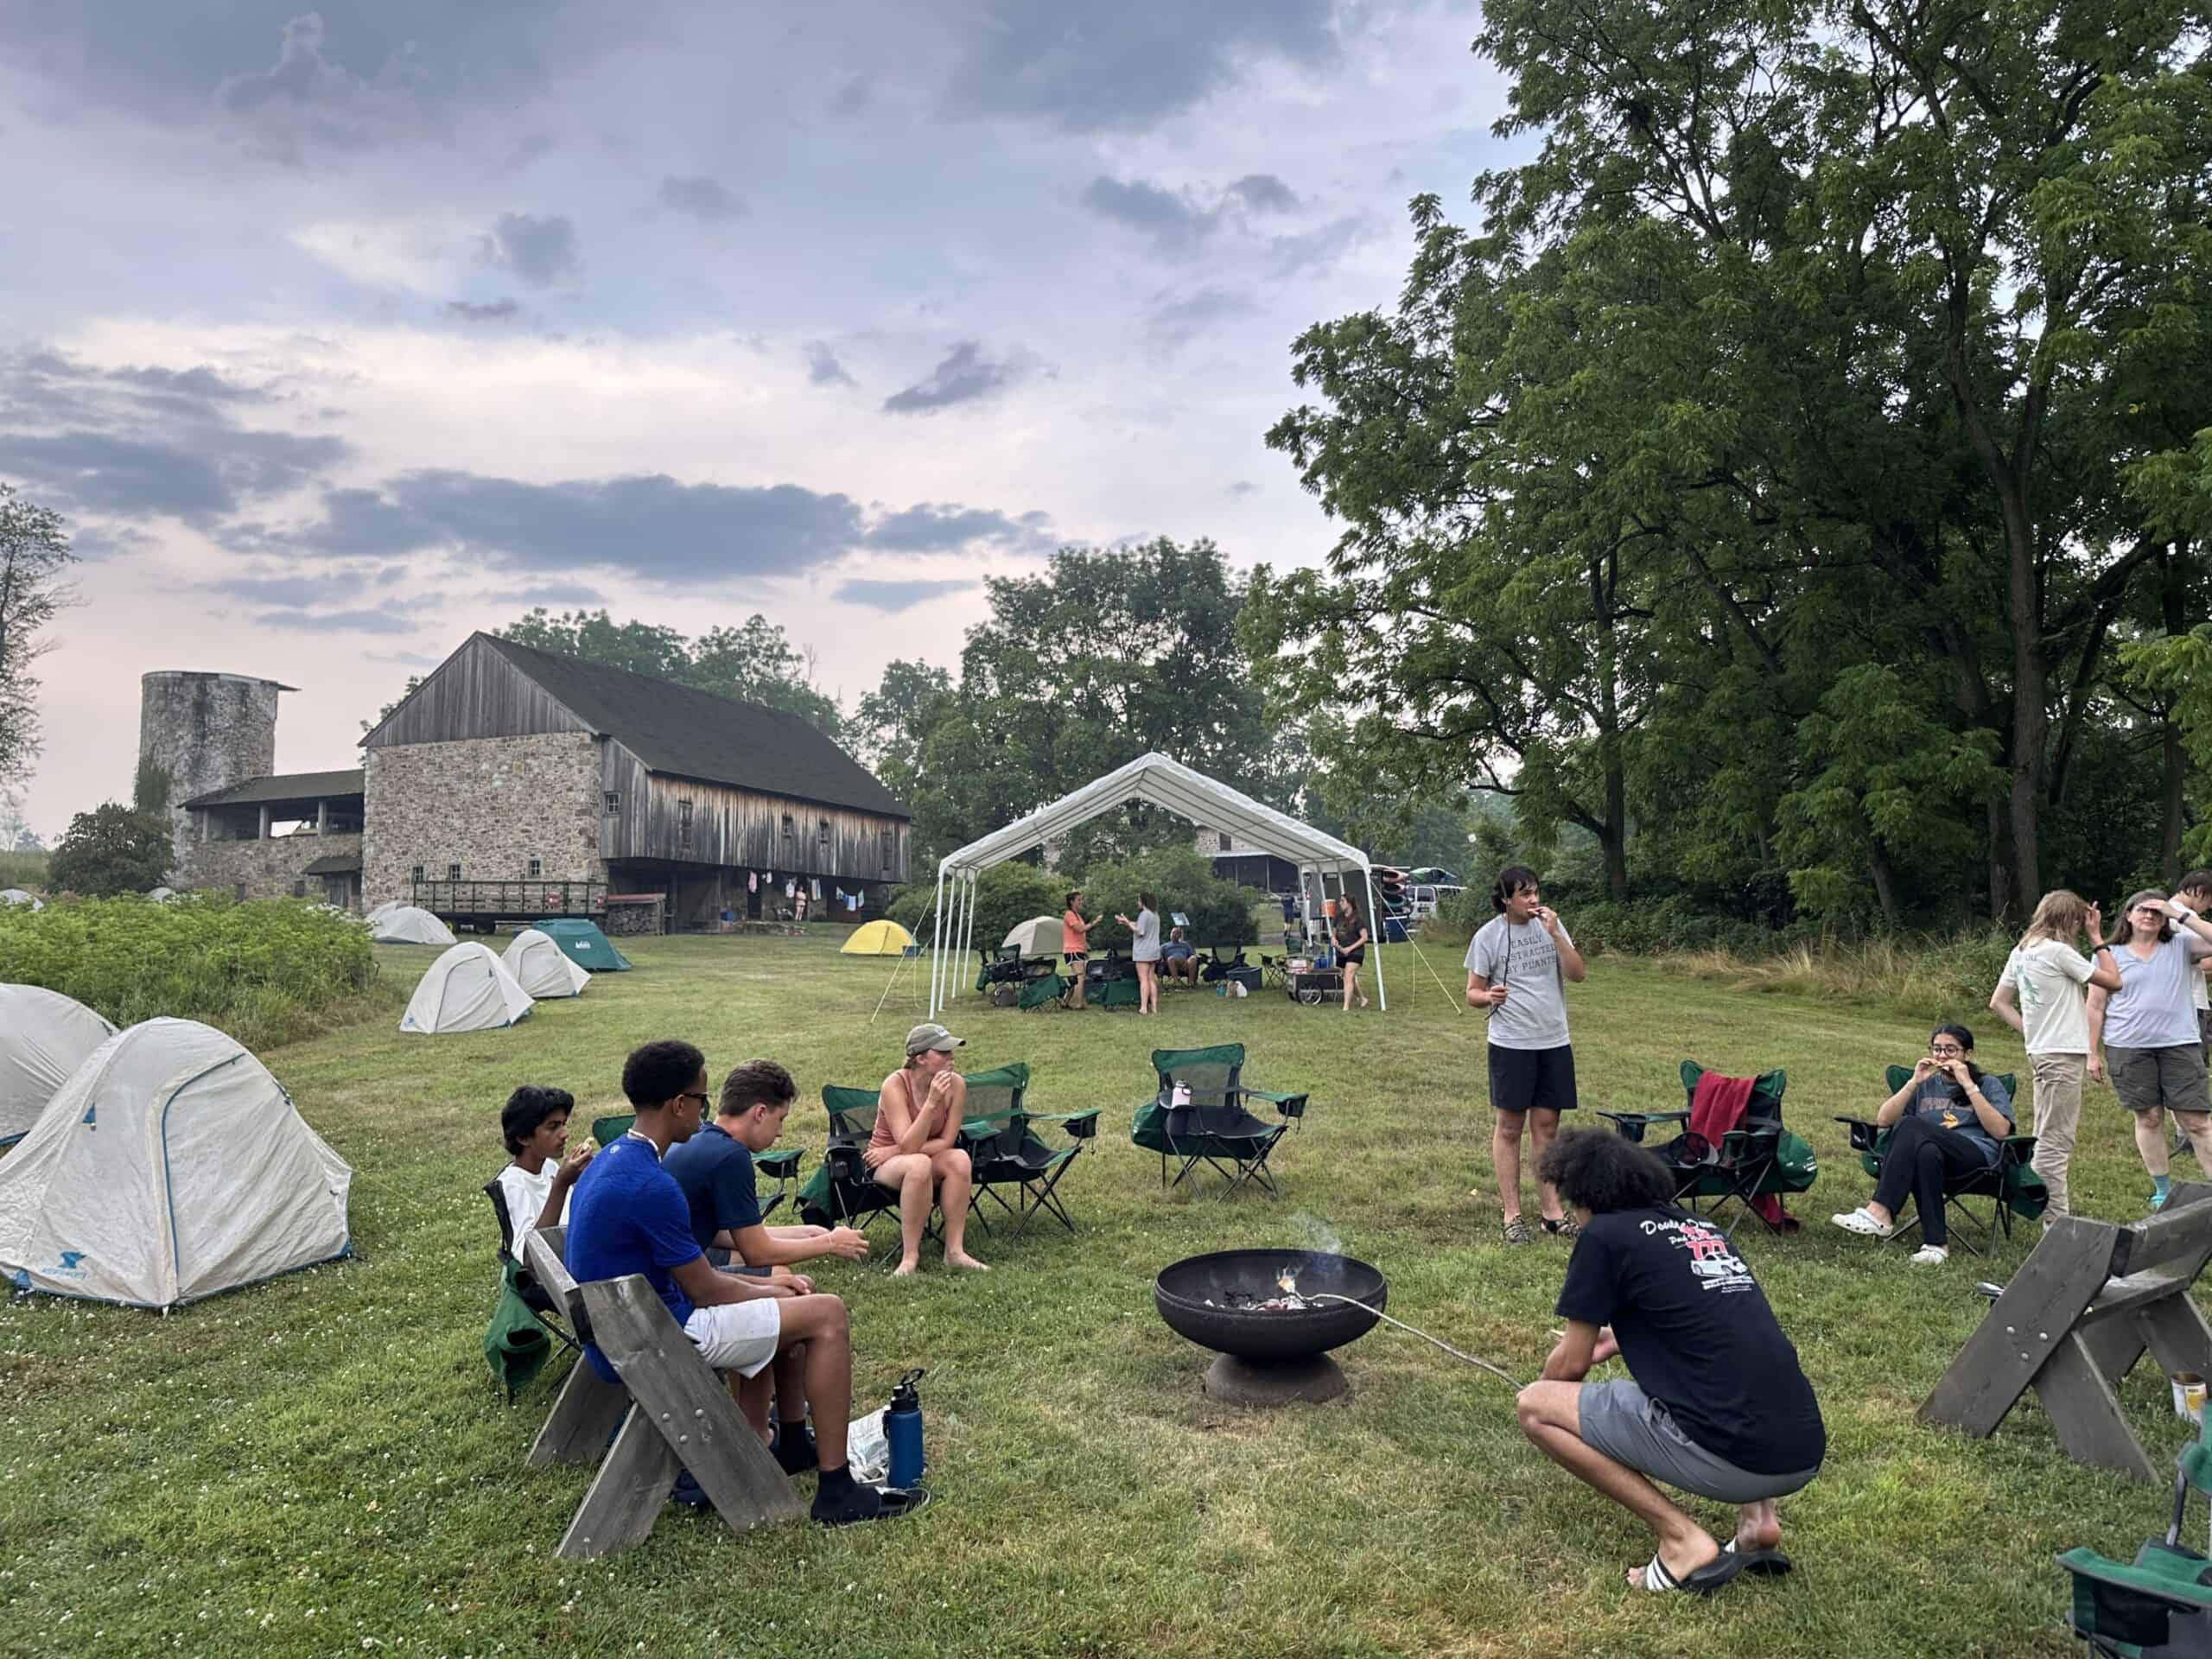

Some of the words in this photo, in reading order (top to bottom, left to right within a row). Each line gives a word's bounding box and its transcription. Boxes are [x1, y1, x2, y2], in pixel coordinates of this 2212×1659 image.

[1510, 934, 1542, 949] EASILY
[1500, 944, 1558, 964] DSTRACTED
[1522, 956, 1556, 970] PLANTS
